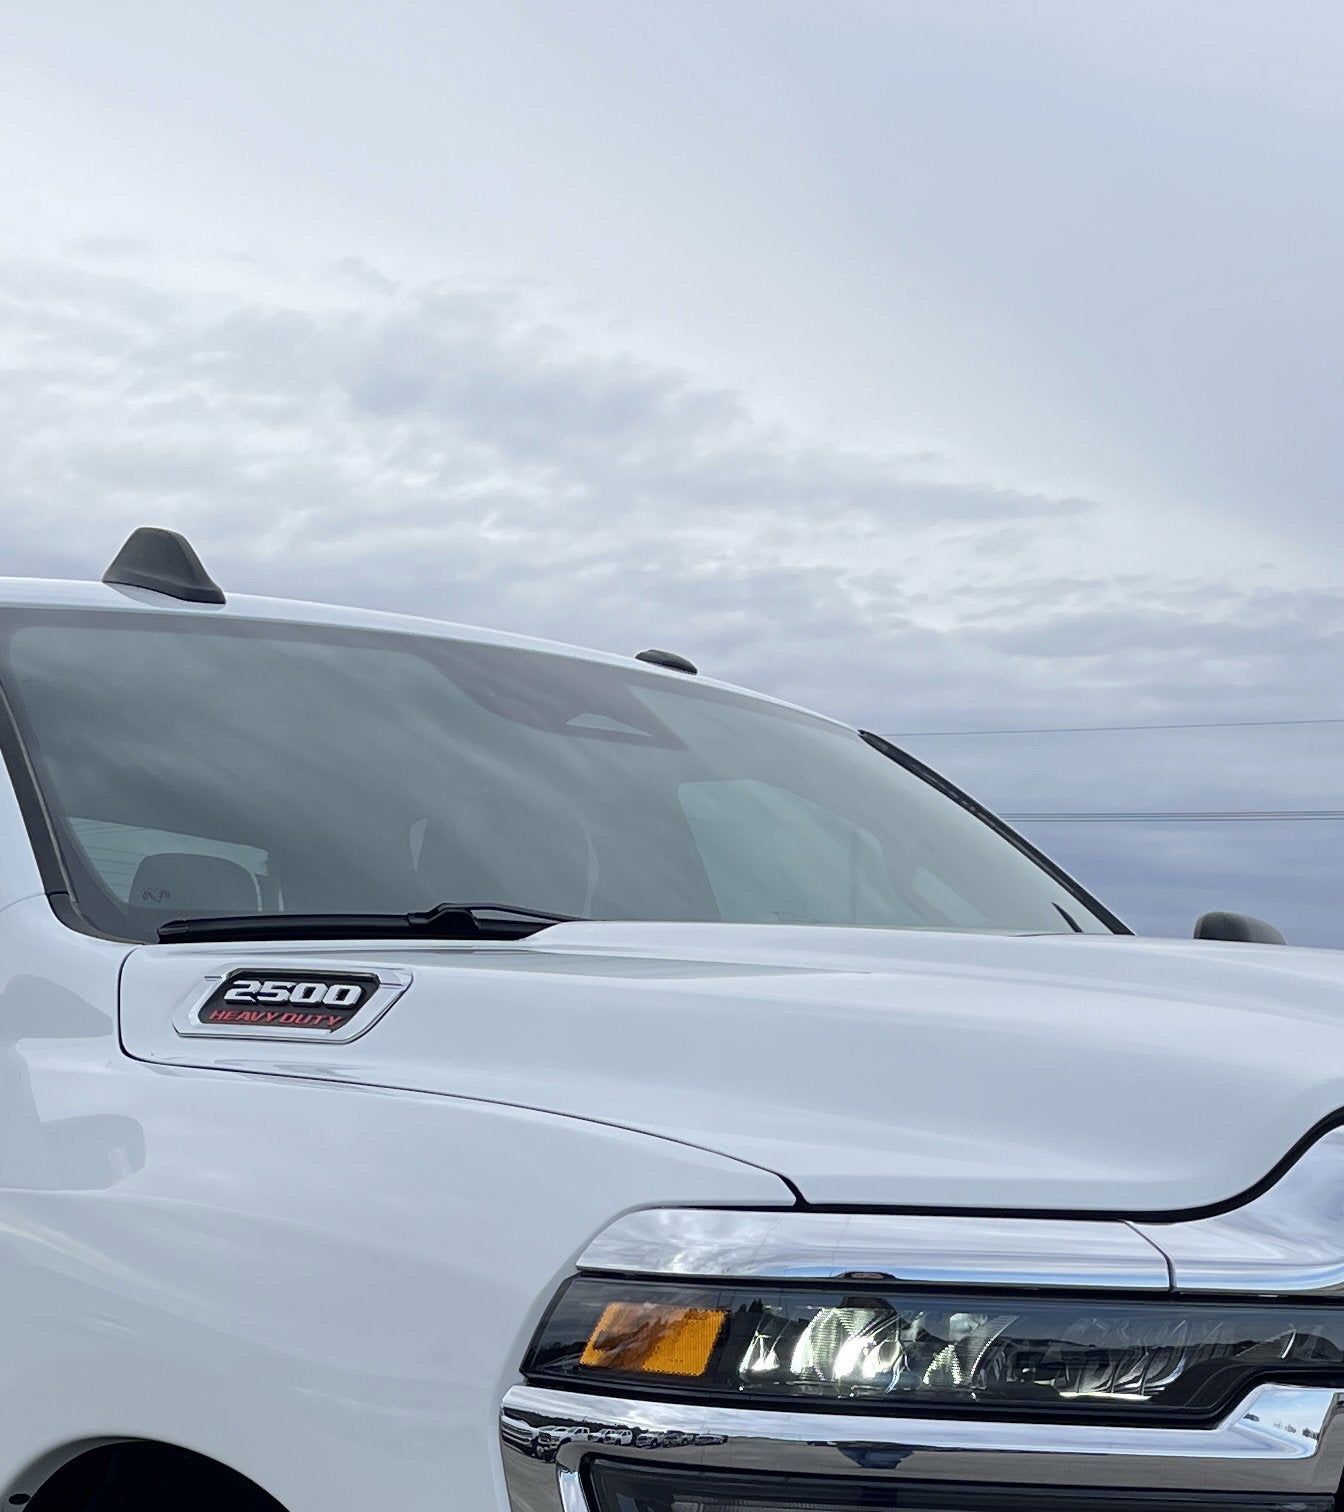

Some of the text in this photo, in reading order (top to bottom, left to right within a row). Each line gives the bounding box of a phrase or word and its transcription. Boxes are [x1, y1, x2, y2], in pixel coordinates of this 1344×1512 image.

[223, 979, 363, 1007] 2500
[209, 1009, 346, 1027] HEAVY DUTY
